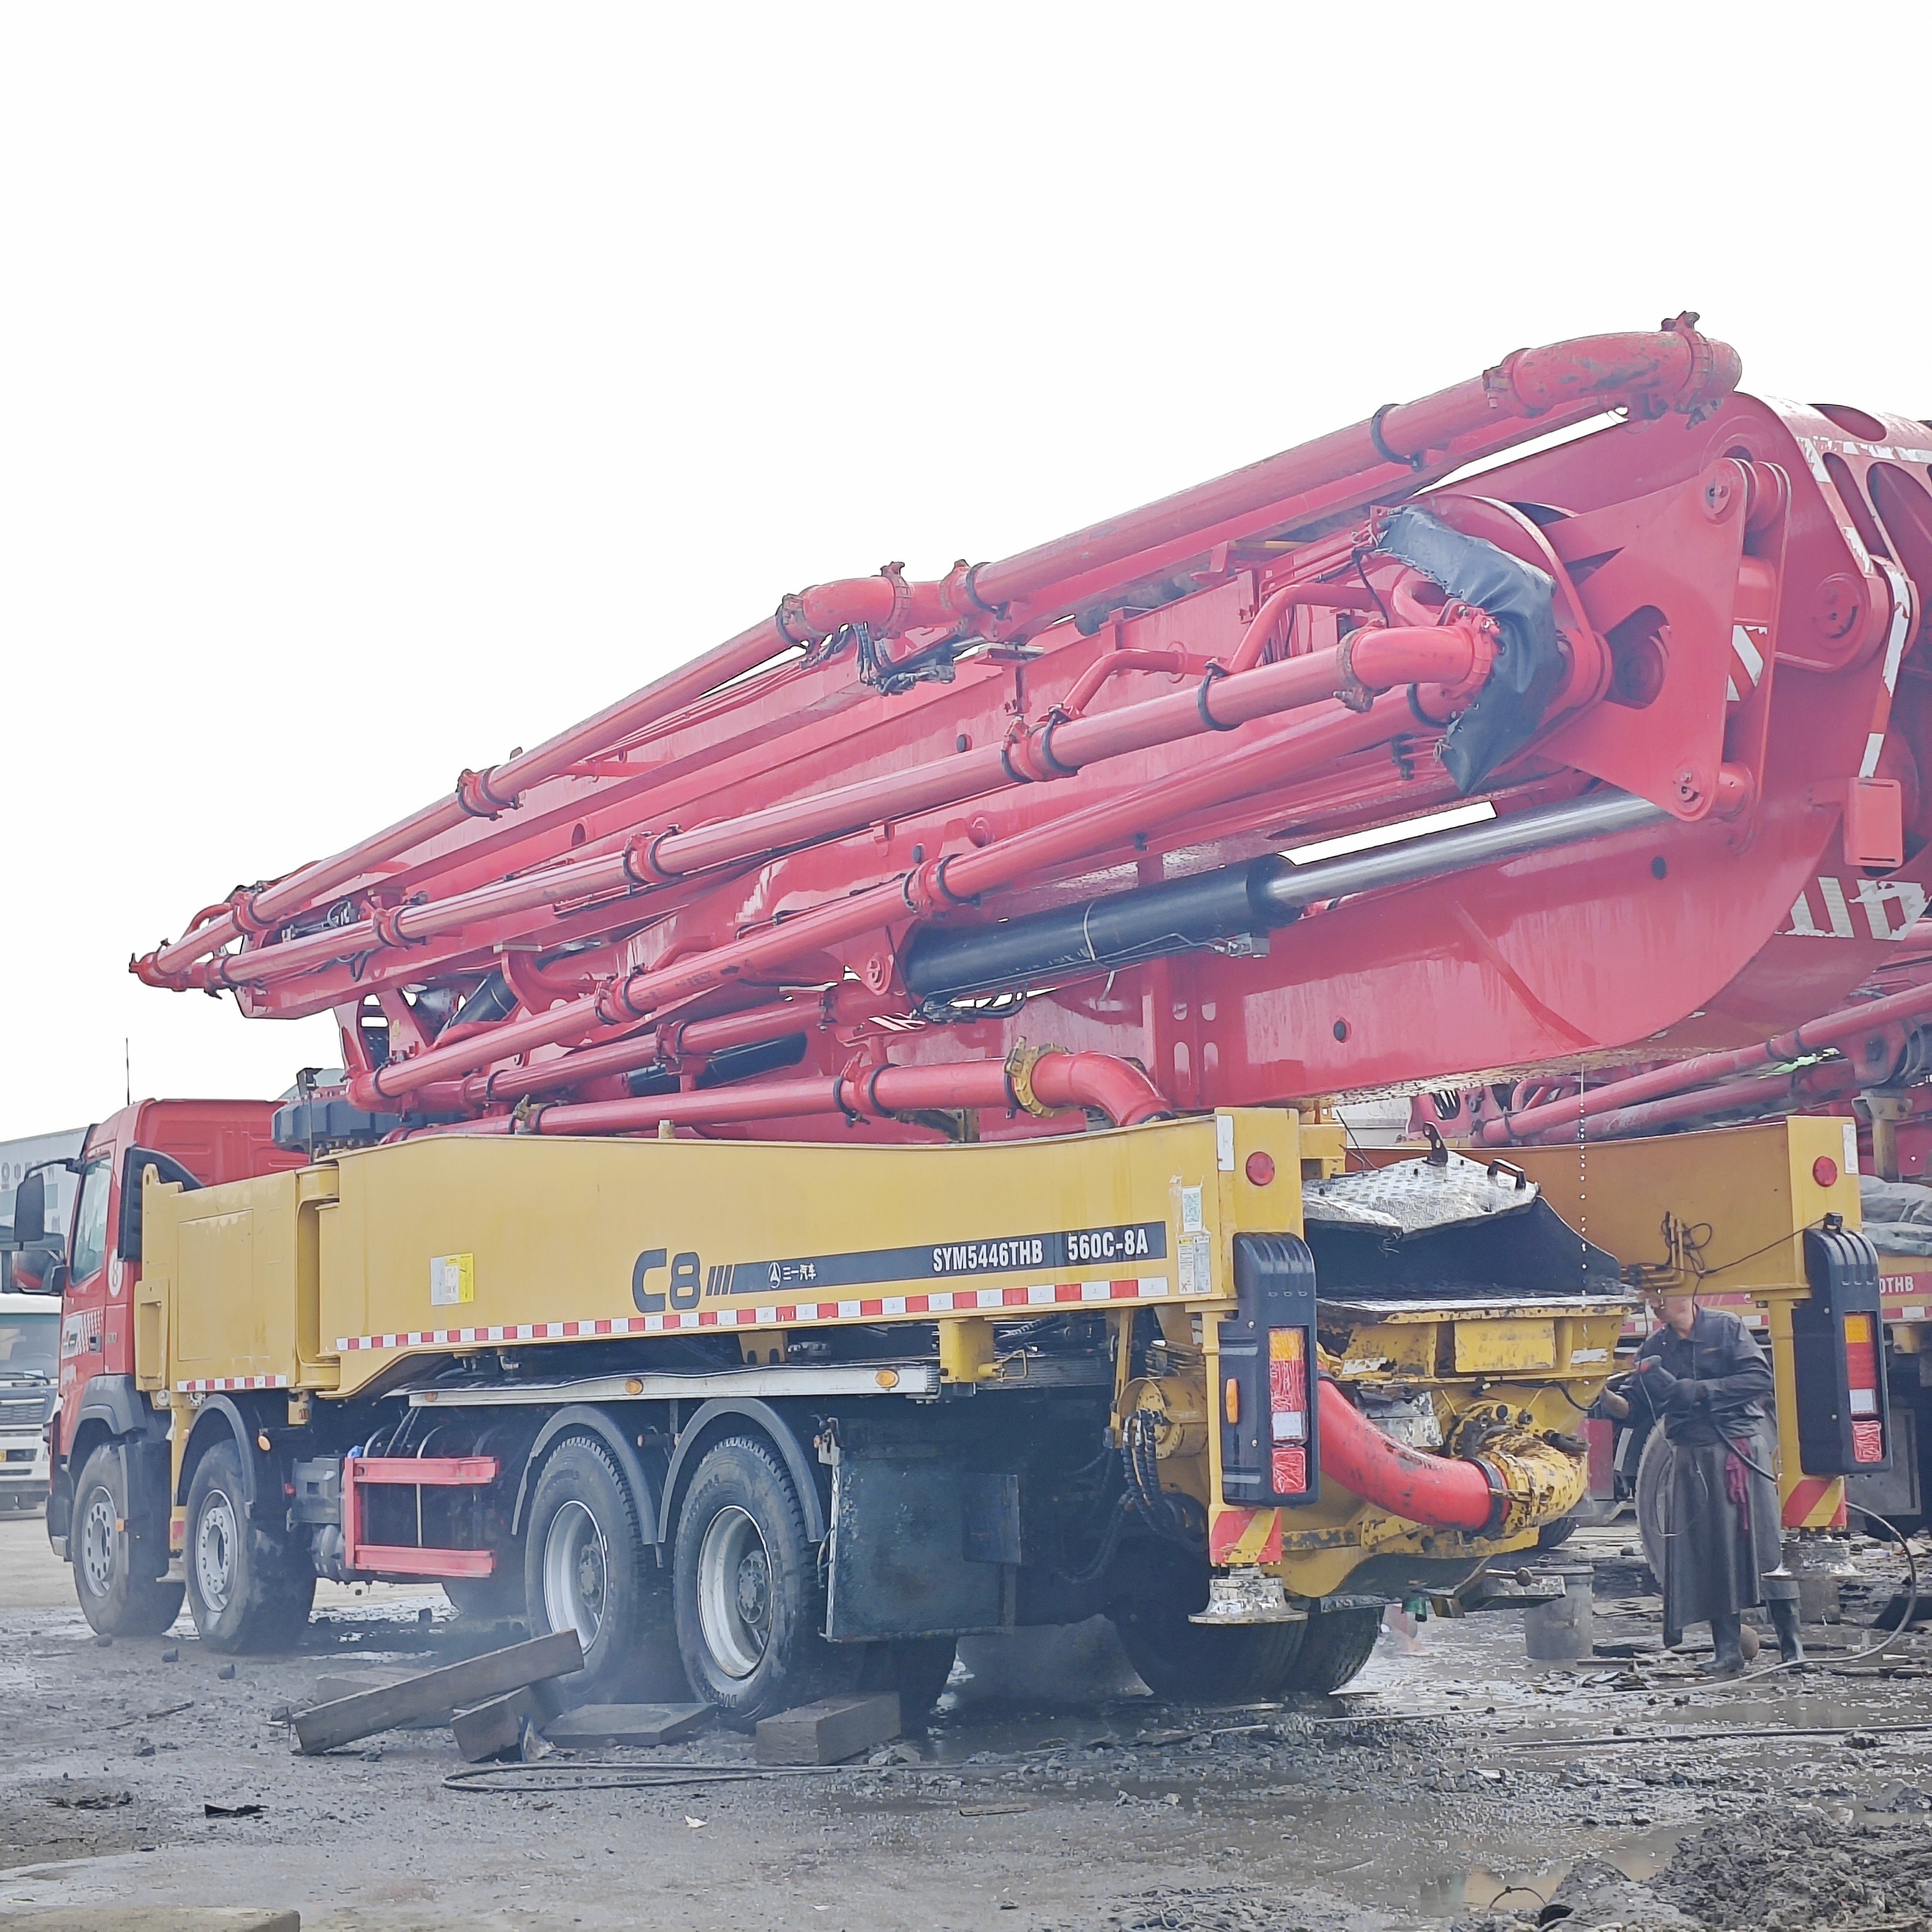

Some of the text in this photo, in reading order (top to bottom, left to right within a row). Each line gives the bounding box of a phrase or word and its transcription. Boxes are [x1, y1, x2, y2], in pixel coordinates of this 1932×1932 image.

[933, 1228, 1148, 1272] SYM5446THB 560C-8A
[632, 1248, 701, 1313] C8
